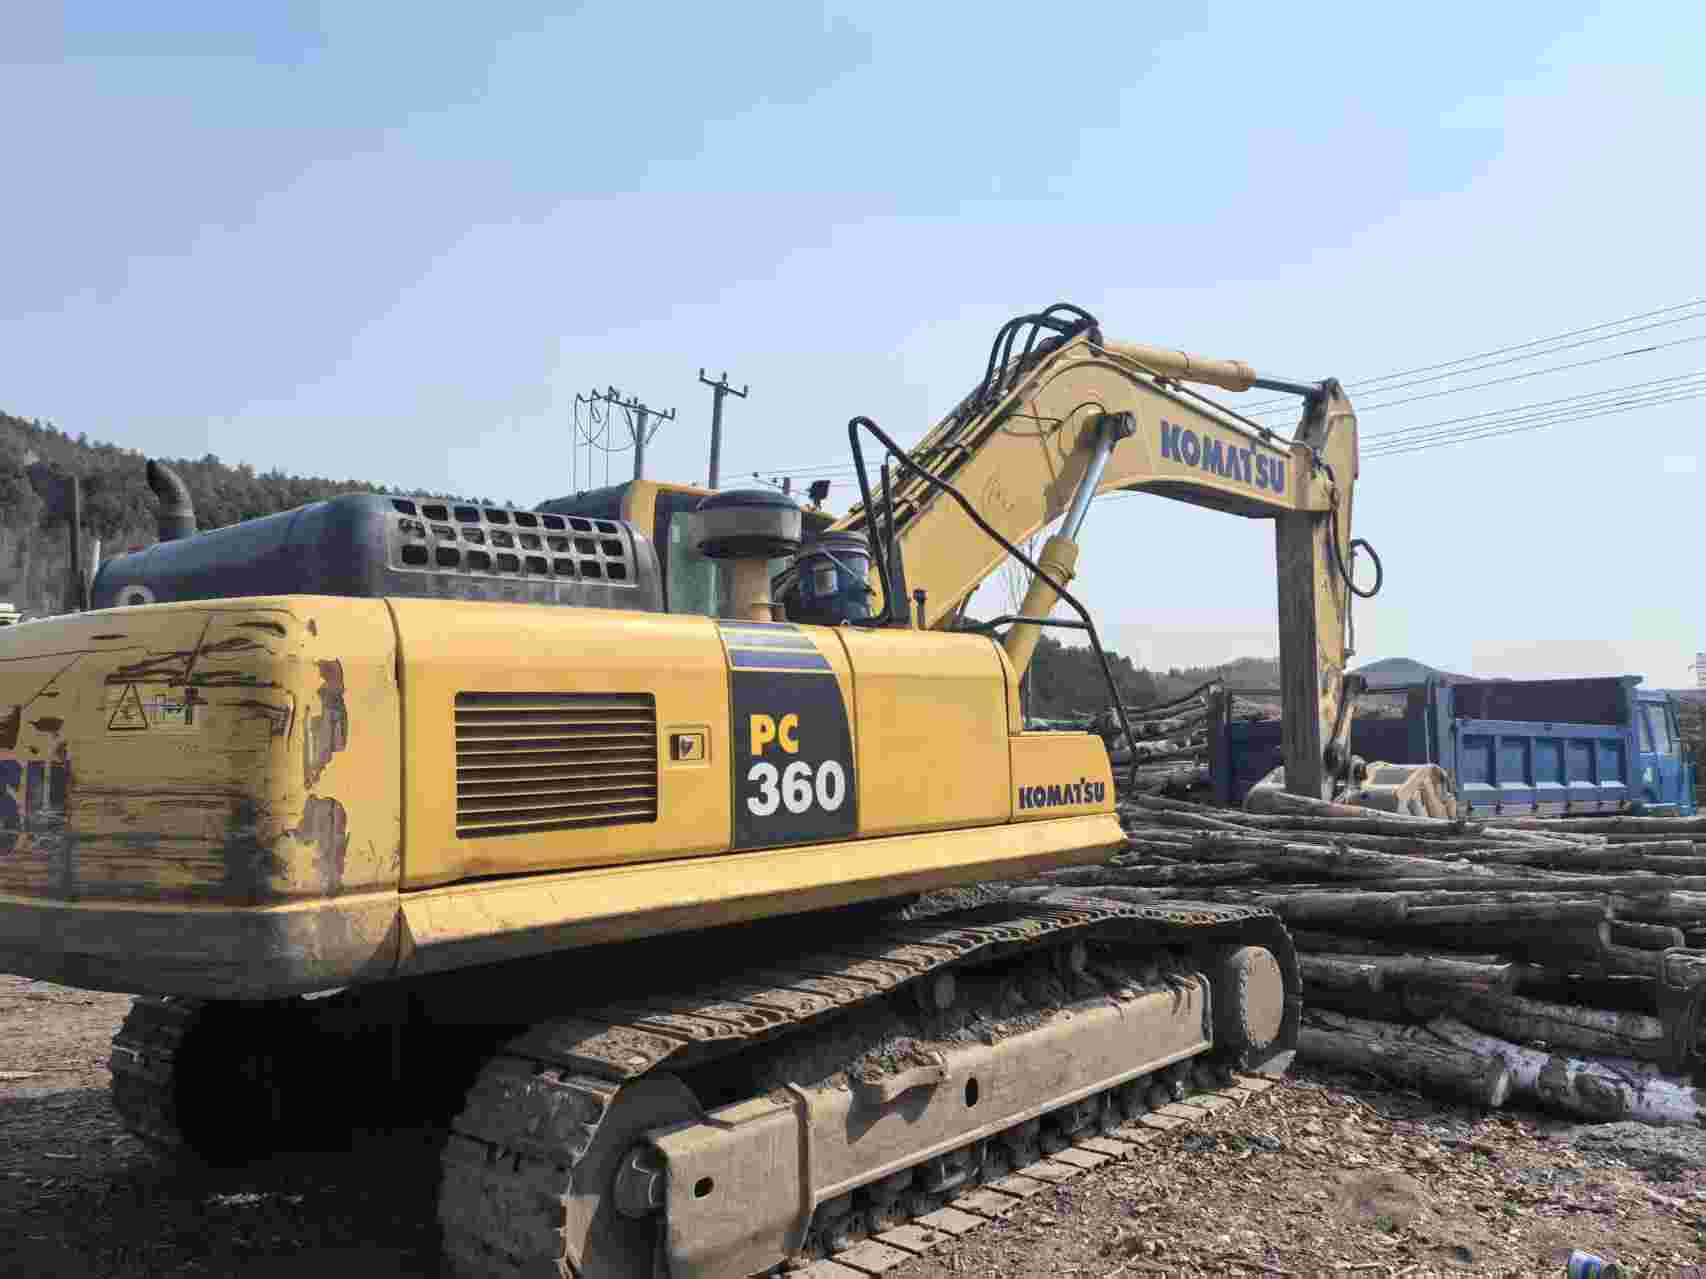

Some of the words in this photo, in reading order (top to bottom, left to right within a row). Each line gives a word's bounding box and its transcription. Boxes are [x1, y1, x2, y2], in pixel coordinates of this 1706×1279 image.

[1161, 419, 1285, 494] KOMATSU
[750, 713, 800, 756] PC
[747, 760, 845, 816] 360
[1018, 778, 1104, 809] KOMATSU
